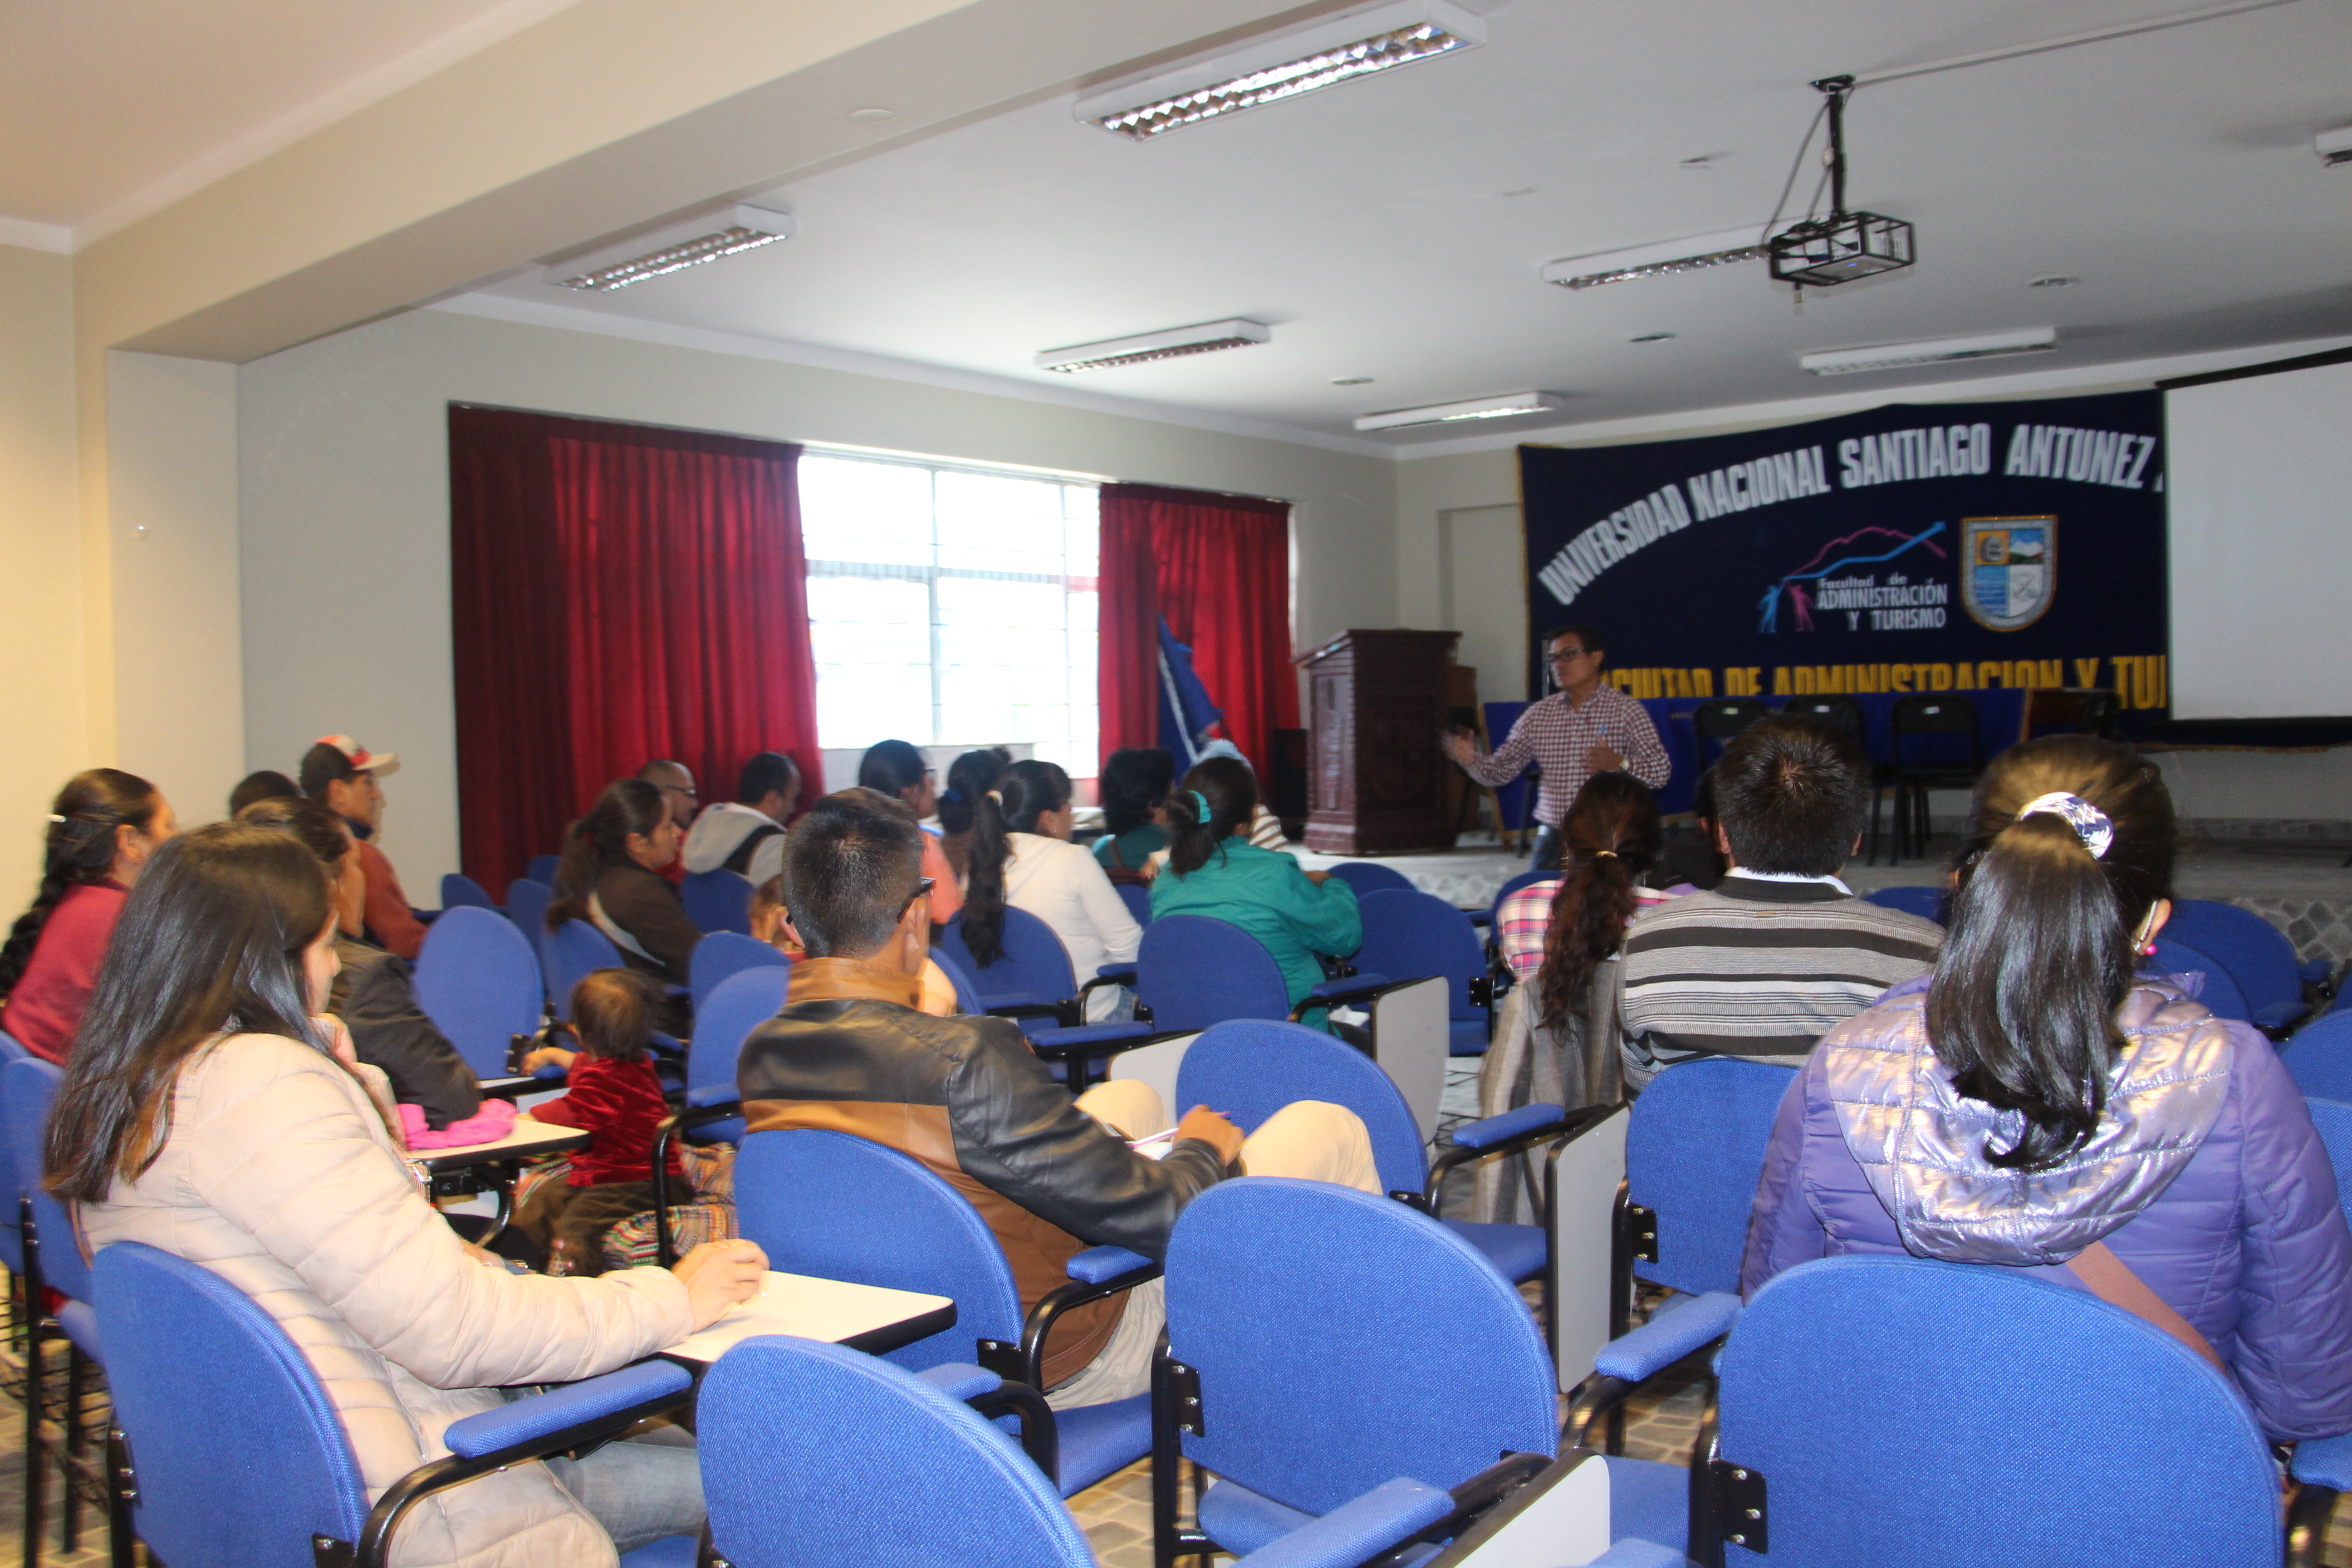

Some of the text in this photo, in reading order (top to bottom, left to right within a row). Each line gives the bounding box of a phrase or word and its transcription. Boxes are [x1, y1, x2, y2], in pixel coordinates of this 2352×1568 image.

[1537, 423, 2156, 605] UNIVERSIDAD NACIONAL SANTIAGO ANTUNEZ
[1817, 578, 1947, 609] ADMINISTRACIÓN
[1818, 573, 1907, 588] Facultad de
[1847, 608, 1946, 631] Y TURISMO
[1725, 667, 1762, 696] DE
[2075, 657, 2099, 688] Y
